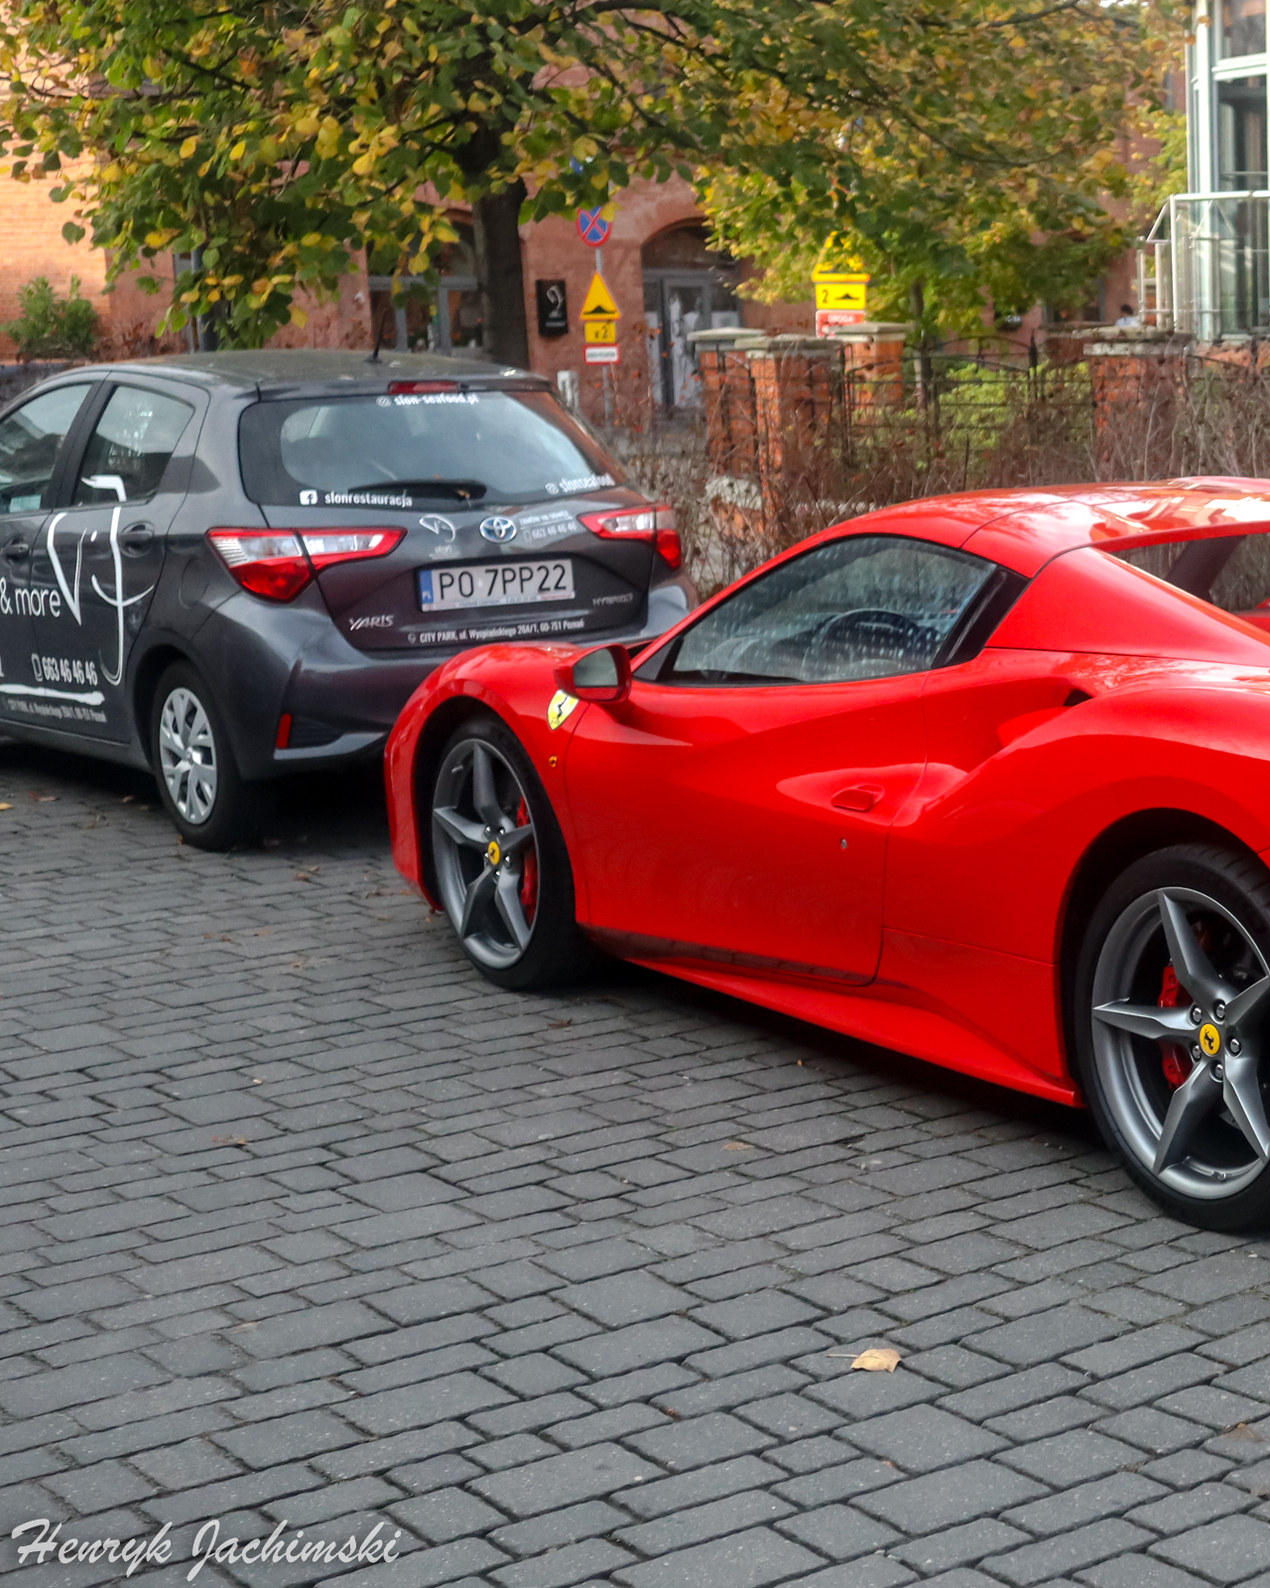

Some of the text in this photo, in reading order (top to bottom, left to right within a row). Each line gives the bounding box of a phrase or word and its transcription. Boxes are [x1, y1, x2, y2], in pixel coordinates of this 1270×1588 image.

[822, 289, 829, 304] 2
[827, 314, 854, 324] DROGA
[324, 489, 413, 508] slonrestauracja
[547, 525, 557, 536] 46
[439, 564, 567, 600] PO 7PP22
[15, 587, 61, 618] more
[422, 591, 432, 600] PL
[349, 614, 395, 631] YARIS
[420, 632, 436, 644] CITY
[42, 656, 98, 686] 663 46 46 46
